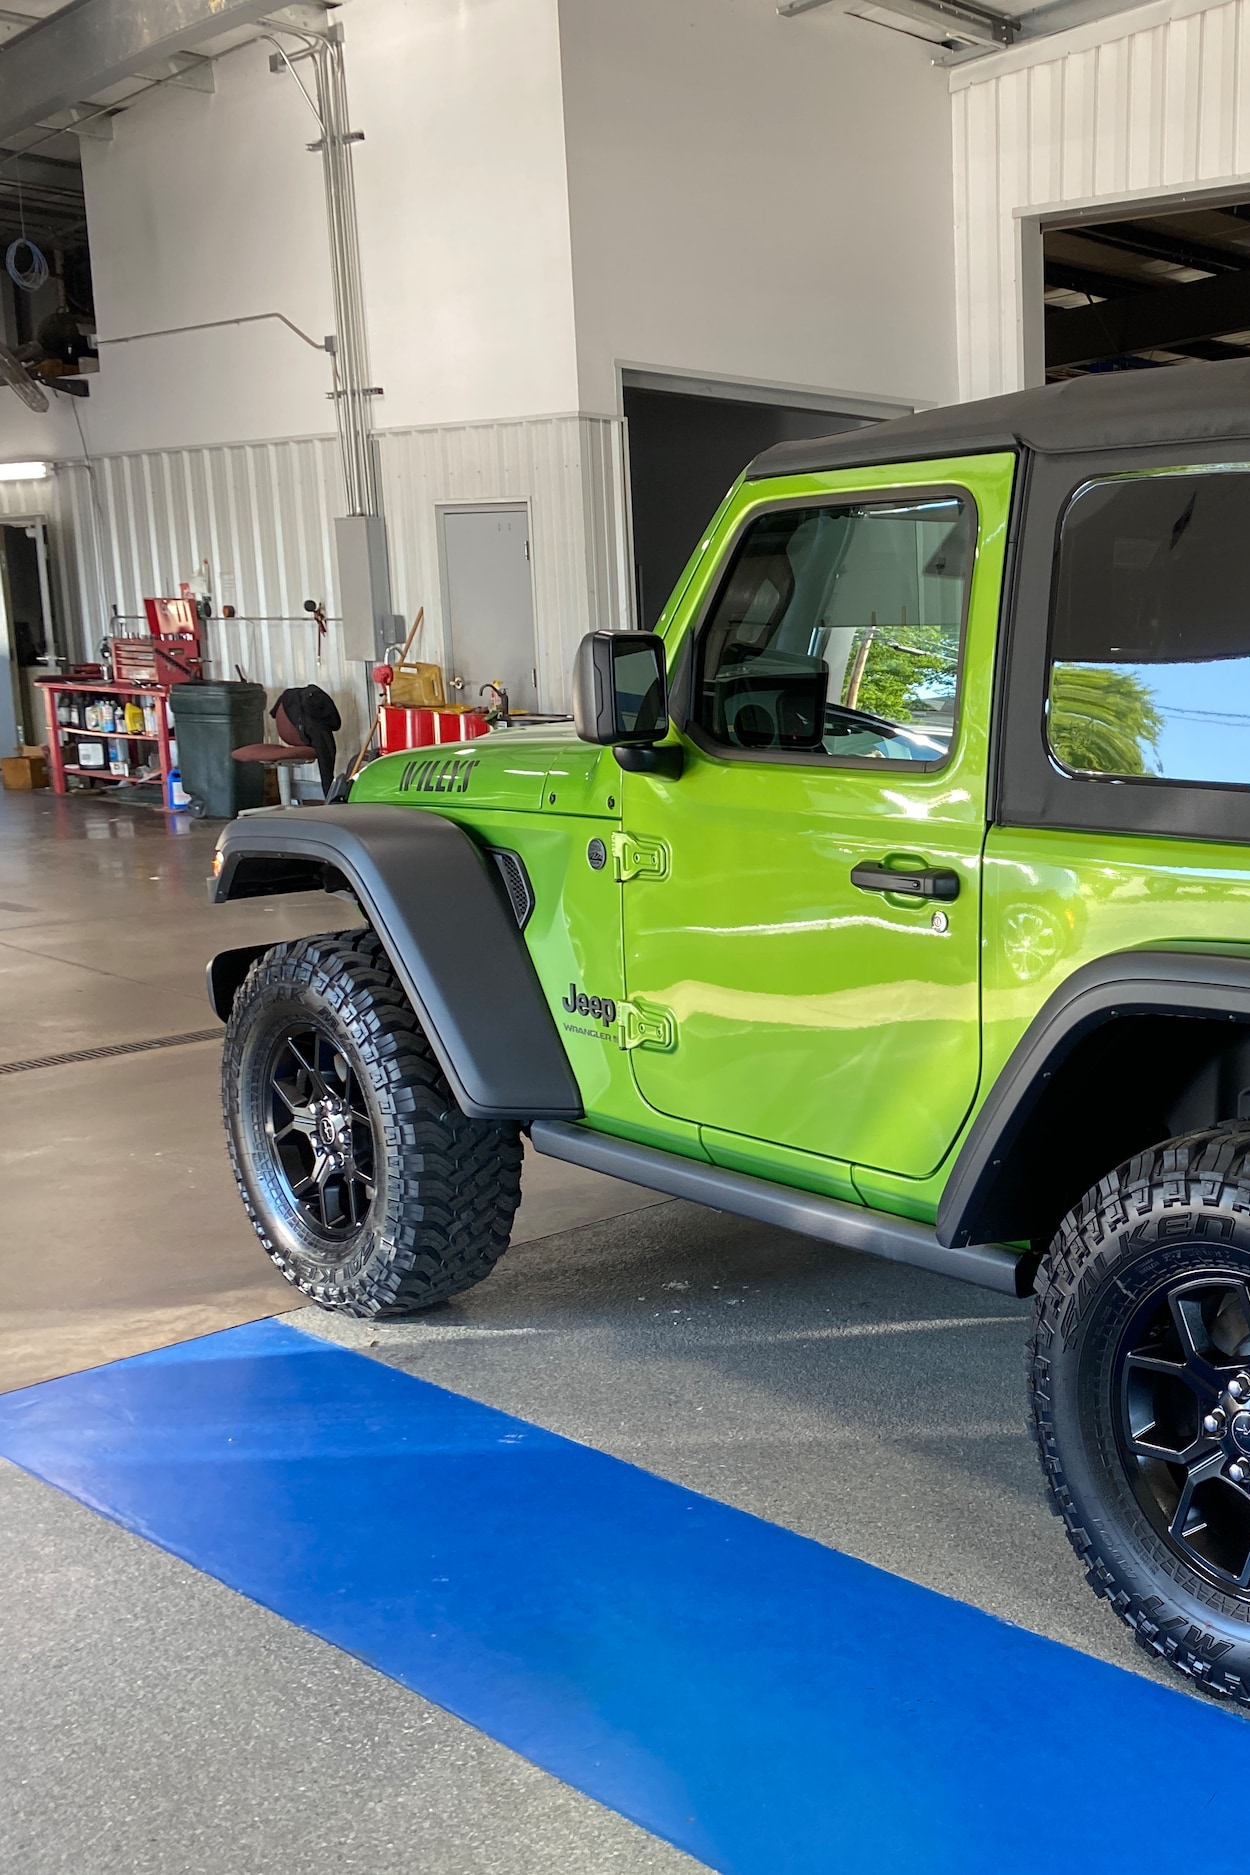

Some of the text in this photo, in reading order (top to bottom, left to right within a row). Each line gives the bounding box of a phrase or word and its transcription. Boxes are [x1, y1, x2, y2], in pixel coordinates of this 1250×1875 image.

[399, 760, 480, 792] WILLYS
[562, 983, 617, 1027] Jeep
[563, 1022, 612, 1042] WRANGLER
[1060, 1212, 1237, 1353] FALKEN
[1132, 1592, 1236, 1662] M/T
